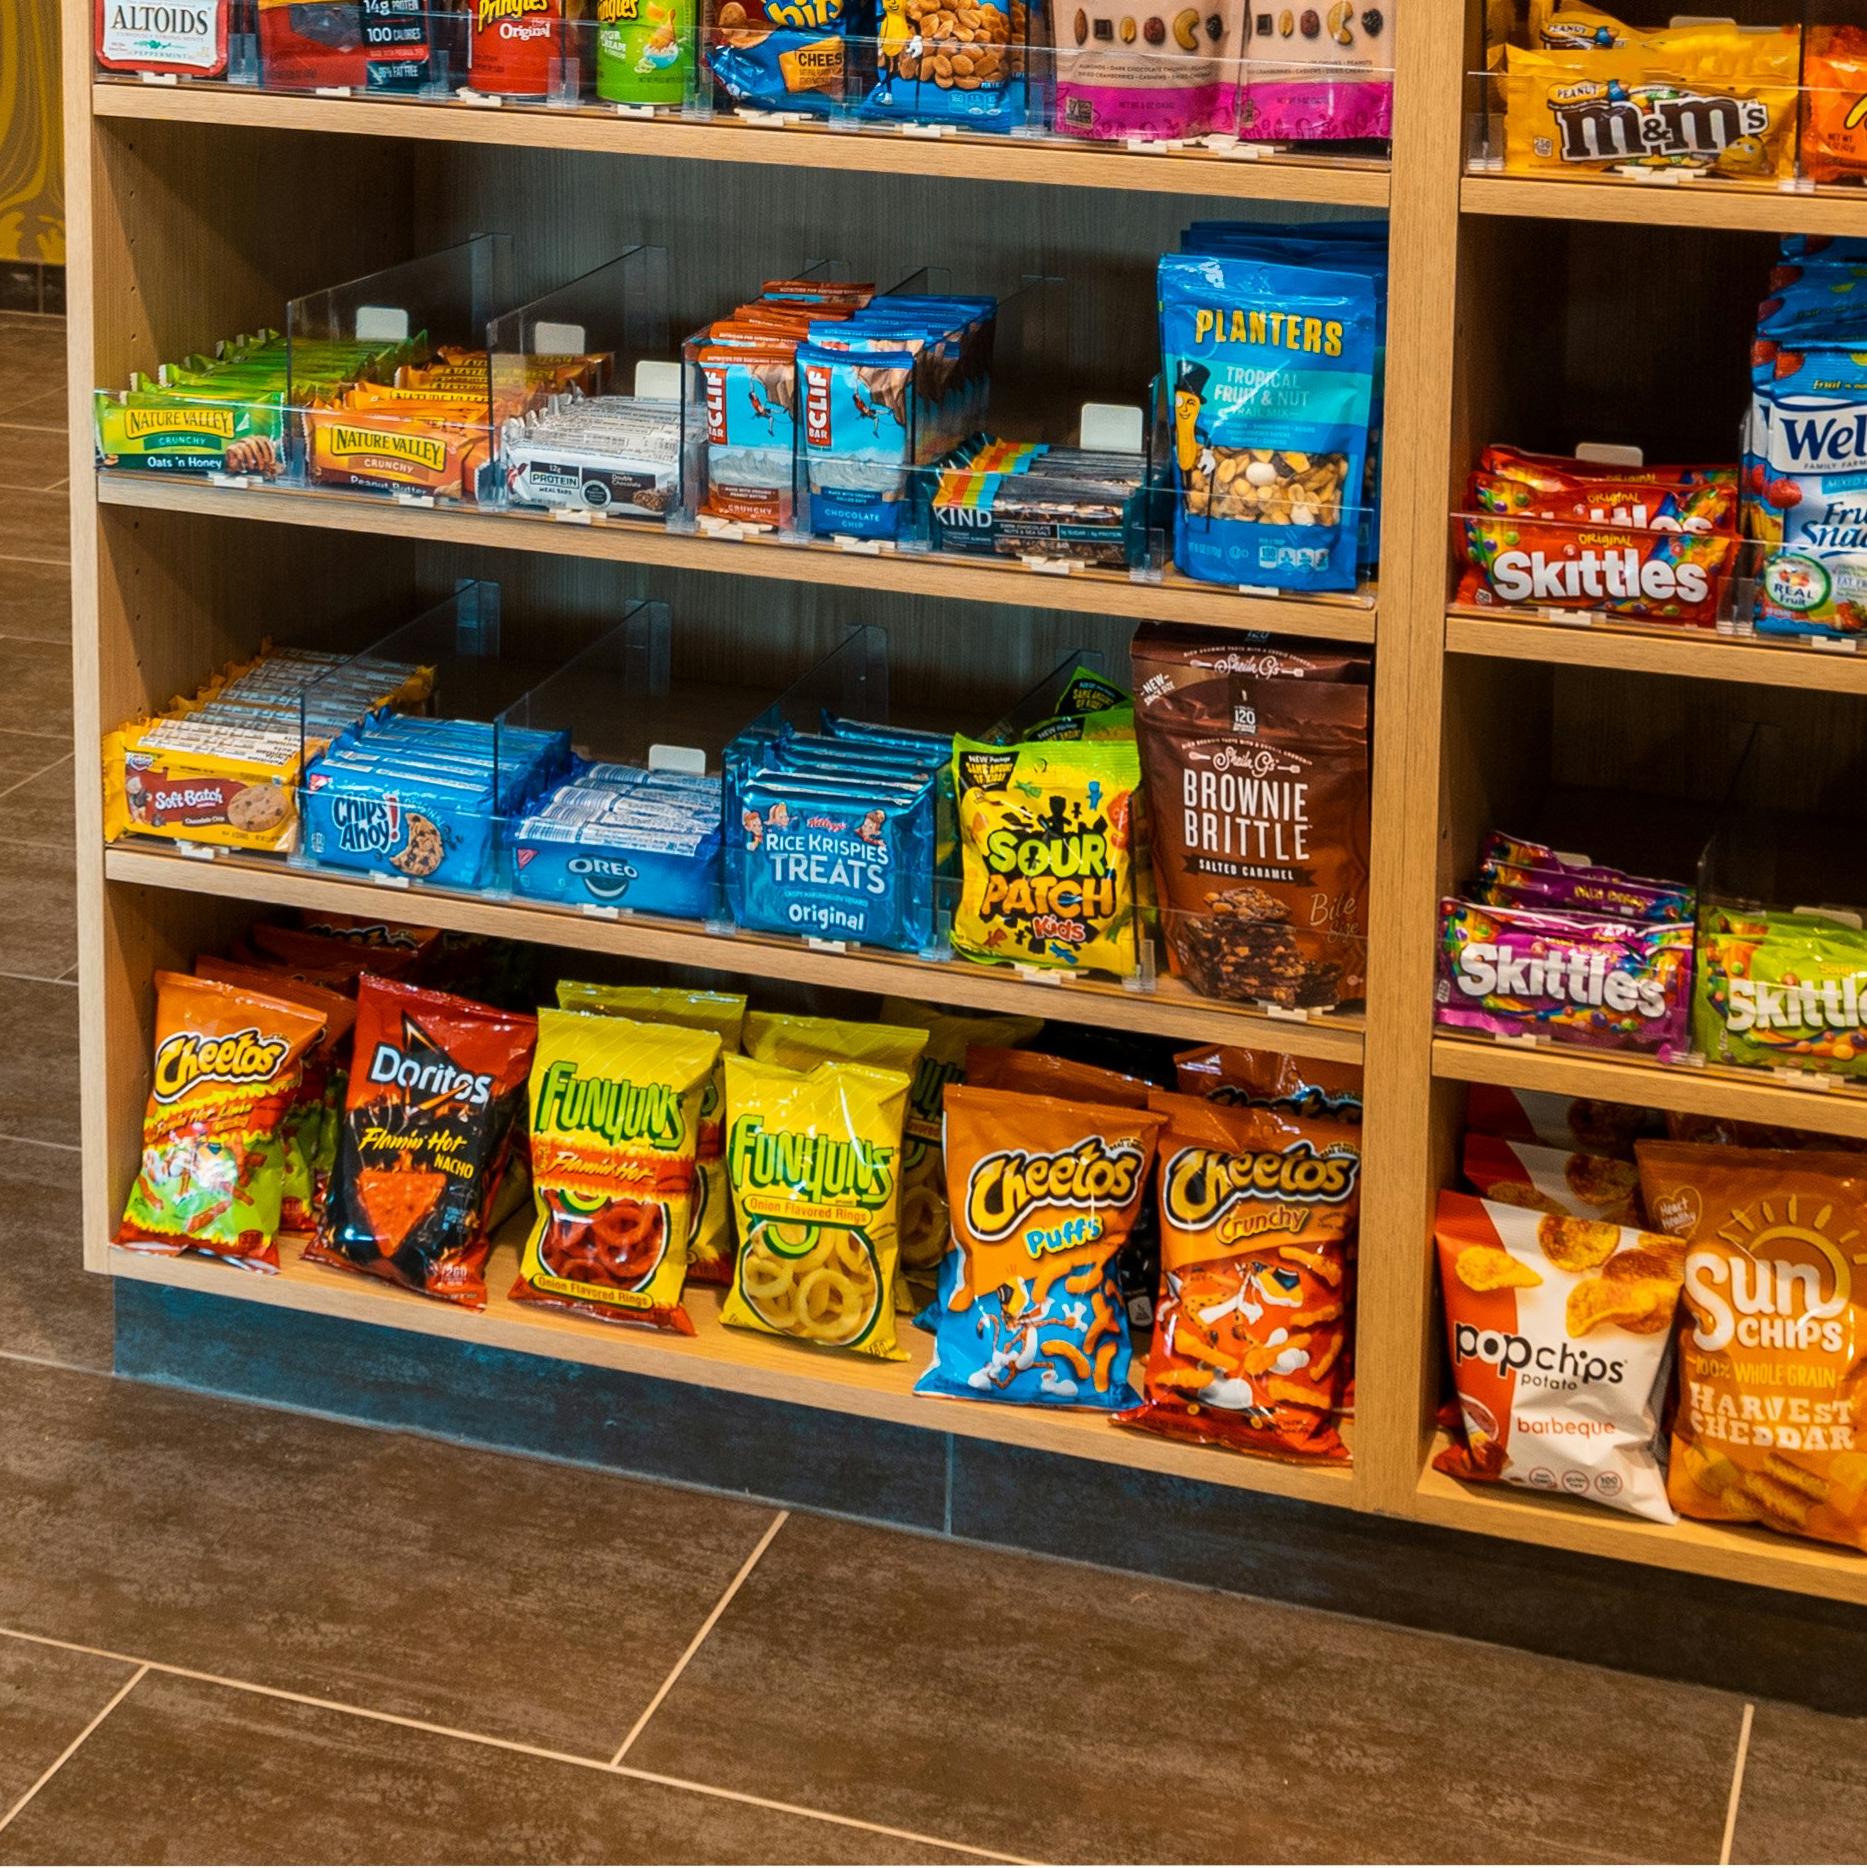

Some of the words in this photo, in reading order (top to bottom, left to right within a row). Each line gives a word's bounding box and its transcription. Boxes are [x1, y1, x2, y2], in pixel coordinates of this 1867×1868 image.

[111, 5, 208, 35] ALTOIDS
[364, 0, 389, 15] 14g
[392, 0, 419, 10] PROTEIN
[367, 28, 392, 42] 100
[394, 28, 420, 40] CALORIES
[500, 23, 551, 41] Original
[798, 53, 842, 66] CHEES
[1556, 85, 1598, 98] PEANUT
[1196, 310, 1342, 356] PLANTERS
[1227, 366, 1300, 388] TROPICAL
[708, 370, 723, 422] CLIF
[809, 370, 828, 423] CLIF
[1214, 385, 1256, 403] FRUIT
[1279, 392, 1310, 406] NUT
[131, 412, 180, 433] NATURE
[183, 412, 231, 433] VALLEY
[809, 428, 827, 439] BAR
[337, 429, 390, 450] NATURE
[392, 437, 441, 466] VALLEY
[147, 457, 172, 467] Oats
[188, 458, 222, 469] Honey
[364, 459, 414, 474] CRUNCHY
[351, 475, 388, 490] Peanut
[533, 474, 576, 486] PROTEIN
[728, 504, 772, 514] CRUNCHY
[825, 509, 880, 522] CHOCOLATE
[935, 508, 992, 528] KIND
[1493, 548, 1708, 602] Skittles
[1774, 584, 1813, 599] REAL
[1780, 595, 1805, 606] Fruit
[1235, 710, 1256, 724] 120
[155, 791, 183, 810] Soft
[185, 788, 223, 806] Batch
[1184, 769, 1308, 821] BROWNIE
[334, 796, 387, 827] Chips
[1184, 808, 1311, 861] BRITTLE
[766, 834, 805, 851] RICE
[809, 834, 888, 865] KRISPIES
[988, 832, 1106, 878] SOUR
[568, 858, 638, 879] OREO
[770, 854, 885, 894] TREATS
[1199, 859, 1237, 874] SALTED
[1242, 865, 1293, 880] CARAMEL
[984, 875, 1115, 917] PATCH
[789, 904, 864, 931] Original
[1033, 916, 1087, 943] Kids
[1457, 943, 1666, 1018] Skittles
[155, 1029, 289, 1101] Cheetos
[370, 1044, 493, 1105] Doritos
[536, 1061, 686, 1148] FUNYUNS
[428, 1133, 466, 1152] Hot
[435, 1153, 474, 1179] NACHO
[615, 1162, 653, 1182] Hot
[732, 1114, 894, 1209] FUNYUNS
[968, 1138, 1142, 1240] Cheetos
[1165, 1141, 1358, 1229] Cheetos
[749, 1197, 782, 1212] Onion
[785, 1201, 832, 1218] Flavored
[835, 1207, 866, 1223] Rings
[1217, 1204, 1309, 1242] Crunchy
[1025, 1216, 1103, 1259] Puffs
[537, 1274, 568, 1293] Onion
[569, 1281, 615, 1300] Flavored
[617, 1291, 648, 1307] Rings
[1738, 1317, 1842, 1352] CHIPS
[1456, 1323, 1624, 1384] popchips
[1522, 1374, 1577, 1390] potato
[1734, 1362, 1782, 1382] WHOLE
[1787, 1365, 1836, 1388] GRAIN
[1689, 1382, 1853, 1424] HARVEST
[1518, 1417, 1615, 1440] barbeque
[1690, 1411, 1854, 1450] CHEDDAR
